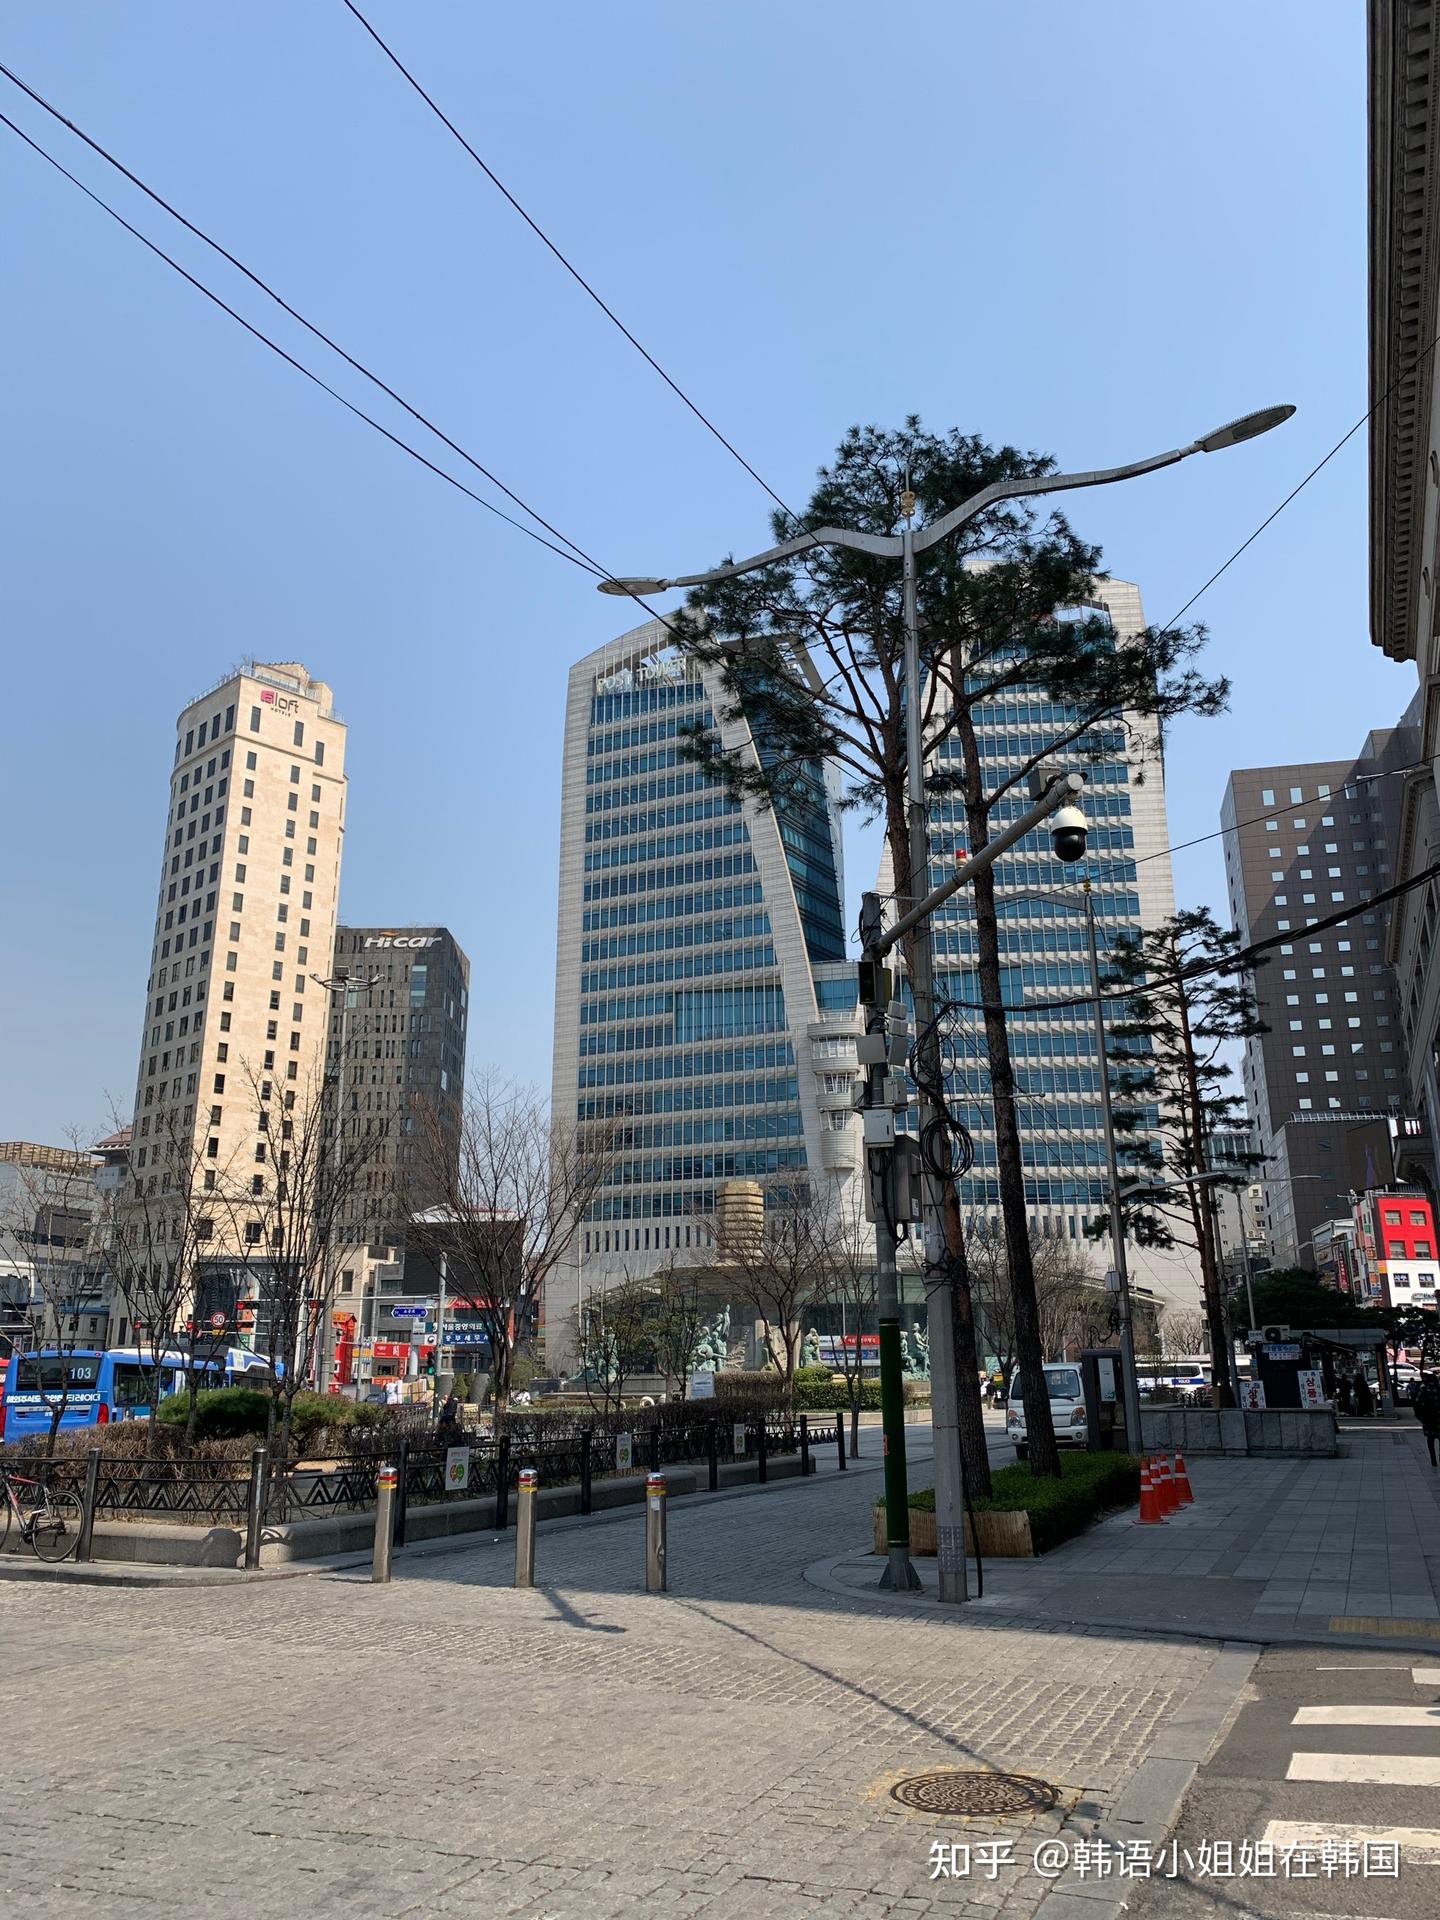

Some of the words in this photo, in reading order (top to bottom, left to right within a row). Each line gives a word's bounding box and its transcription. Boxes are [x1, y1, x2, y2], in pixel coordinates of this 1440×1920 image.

[597, 674, 633, 694] POST
[636, 658, 686, 681] TOWER
[260, 690, 299, 714] aloft
[364, 935, 442, 948] Hicar
[215, 1315, 223, 1324] 50
[70, 1367, 91, 1379] 103
